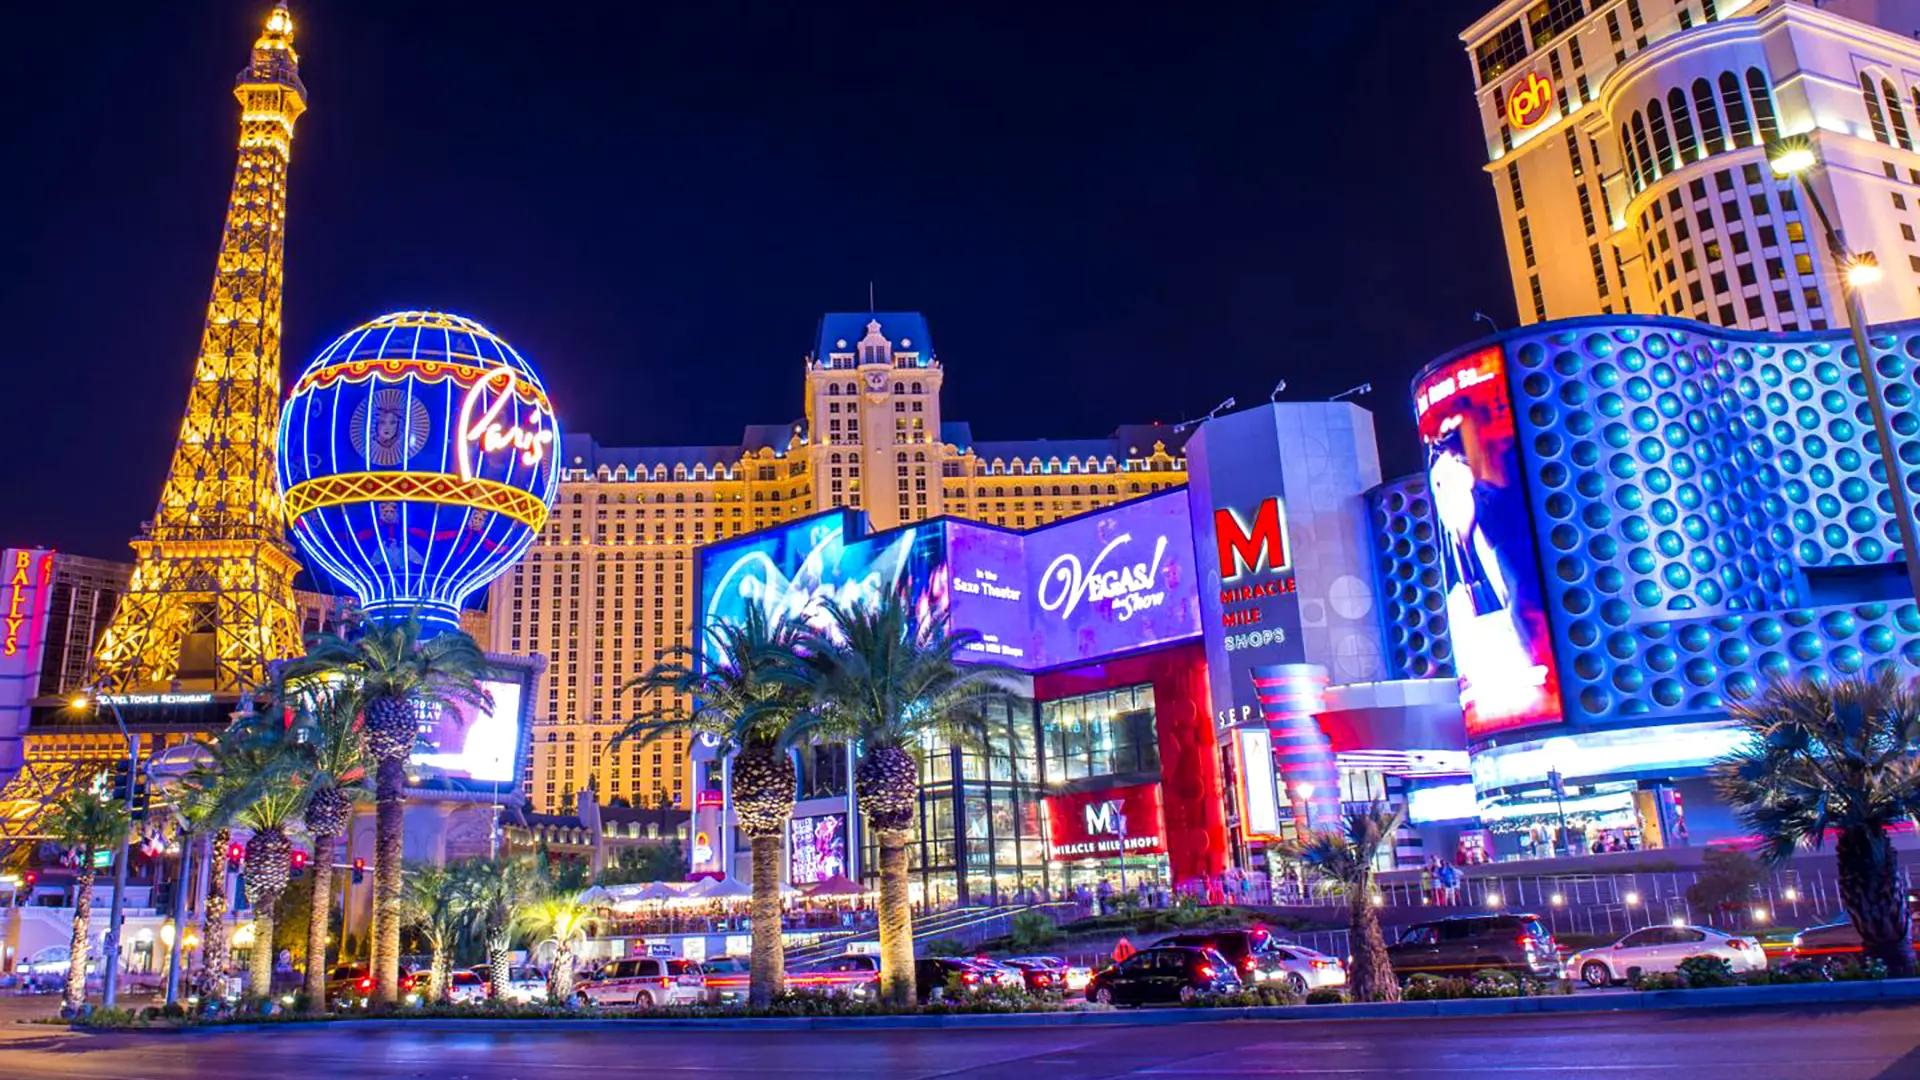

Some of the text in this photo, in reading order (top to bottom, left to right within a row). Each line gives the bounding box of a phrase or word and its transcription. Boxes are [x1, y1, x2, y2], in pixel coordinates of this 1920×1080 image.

[1513, 72, 1552, 125] ph
[458, 365, 553, 483] Paris
[1214, 496, 1291, 582] M
[1219, 576, 1297, 605] MIRACLE
[1118, 591, 1165, 622] Show
[1221, 607, 1262, 628] MILE
[1224, 627, 1286, 651] SHOPS
[1052, 836, 1160, 856] MIRACLE MILE SHOPS
